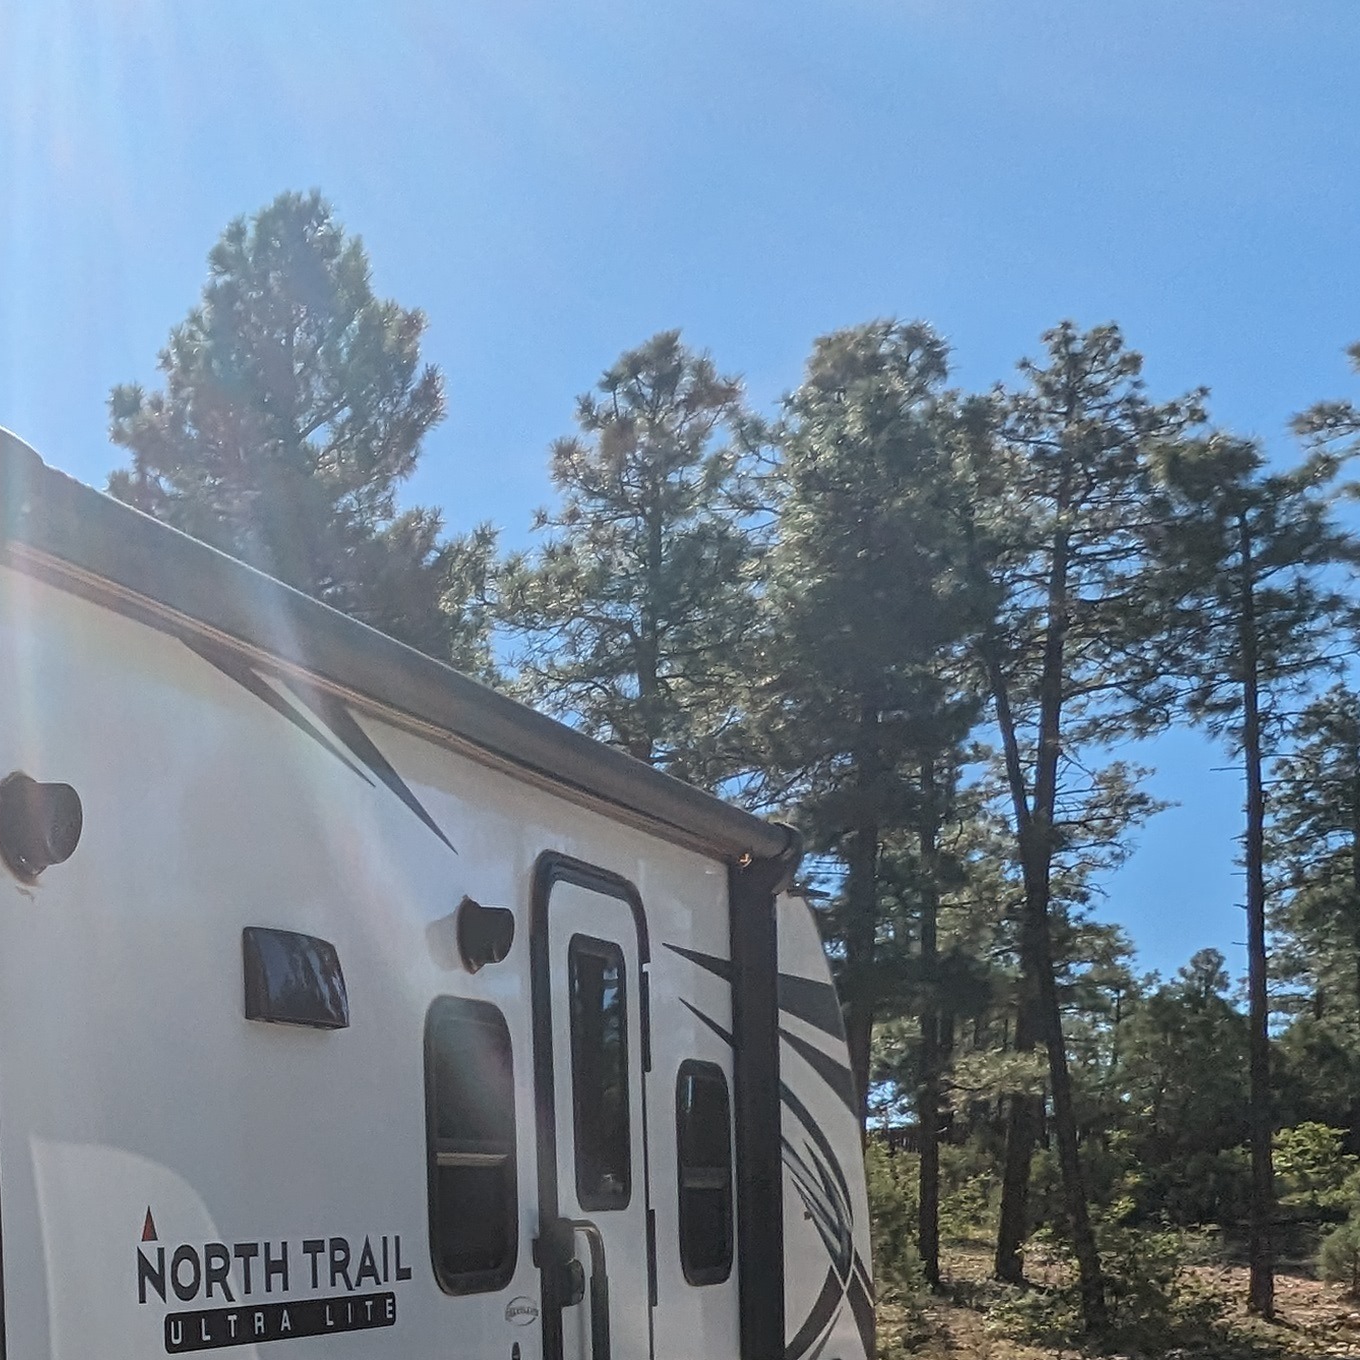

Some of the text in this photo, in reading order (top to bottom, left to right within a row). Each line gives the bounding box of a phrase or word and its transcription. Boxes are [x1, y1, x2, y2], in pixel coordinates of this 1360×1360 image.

[136, 1235, 412, 1304] NORTH TRAIL
[169, 1299, 394, 1345] ULTRA LITE
